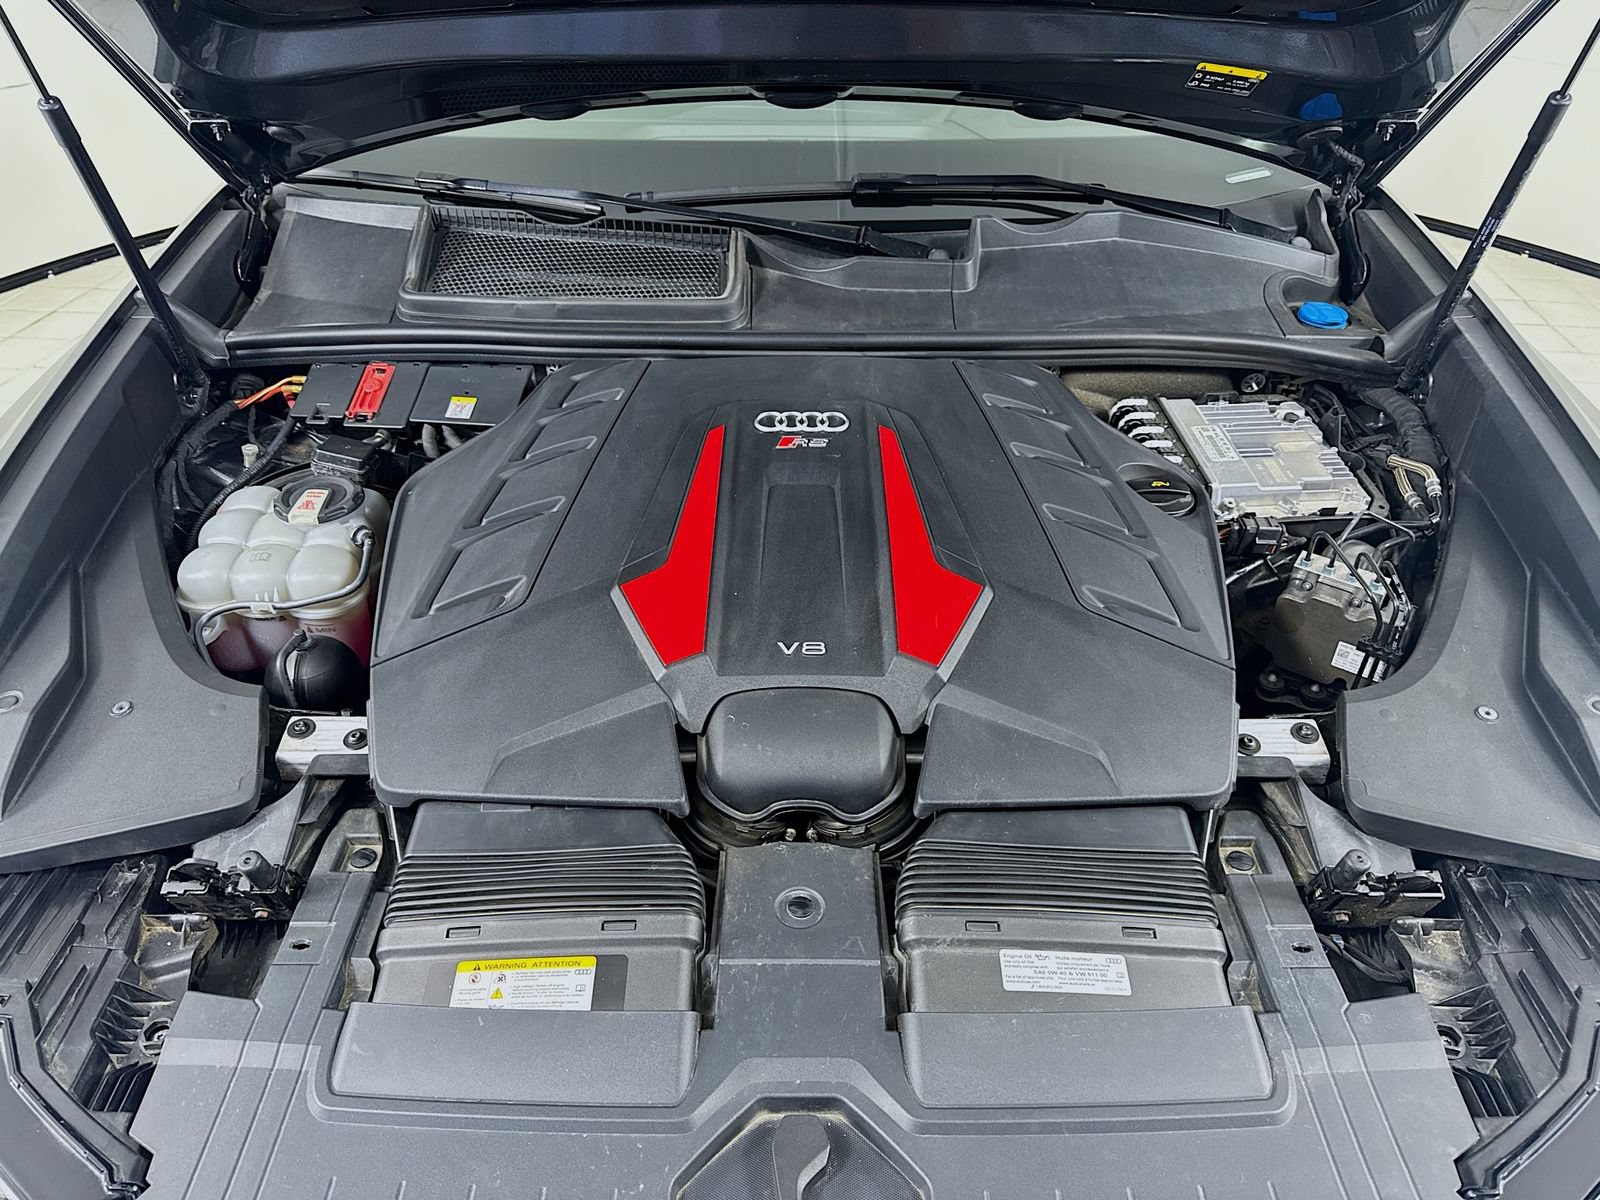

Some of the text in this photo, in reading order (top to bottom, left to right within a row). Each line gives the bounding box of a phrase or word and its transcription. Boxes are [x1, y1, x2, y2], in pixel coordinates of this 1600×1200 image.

[779, 436, 829, 449] RS
[776, 642, 826, 655] V8
[484, 960, 581, 970] WARNING ATTENTION
